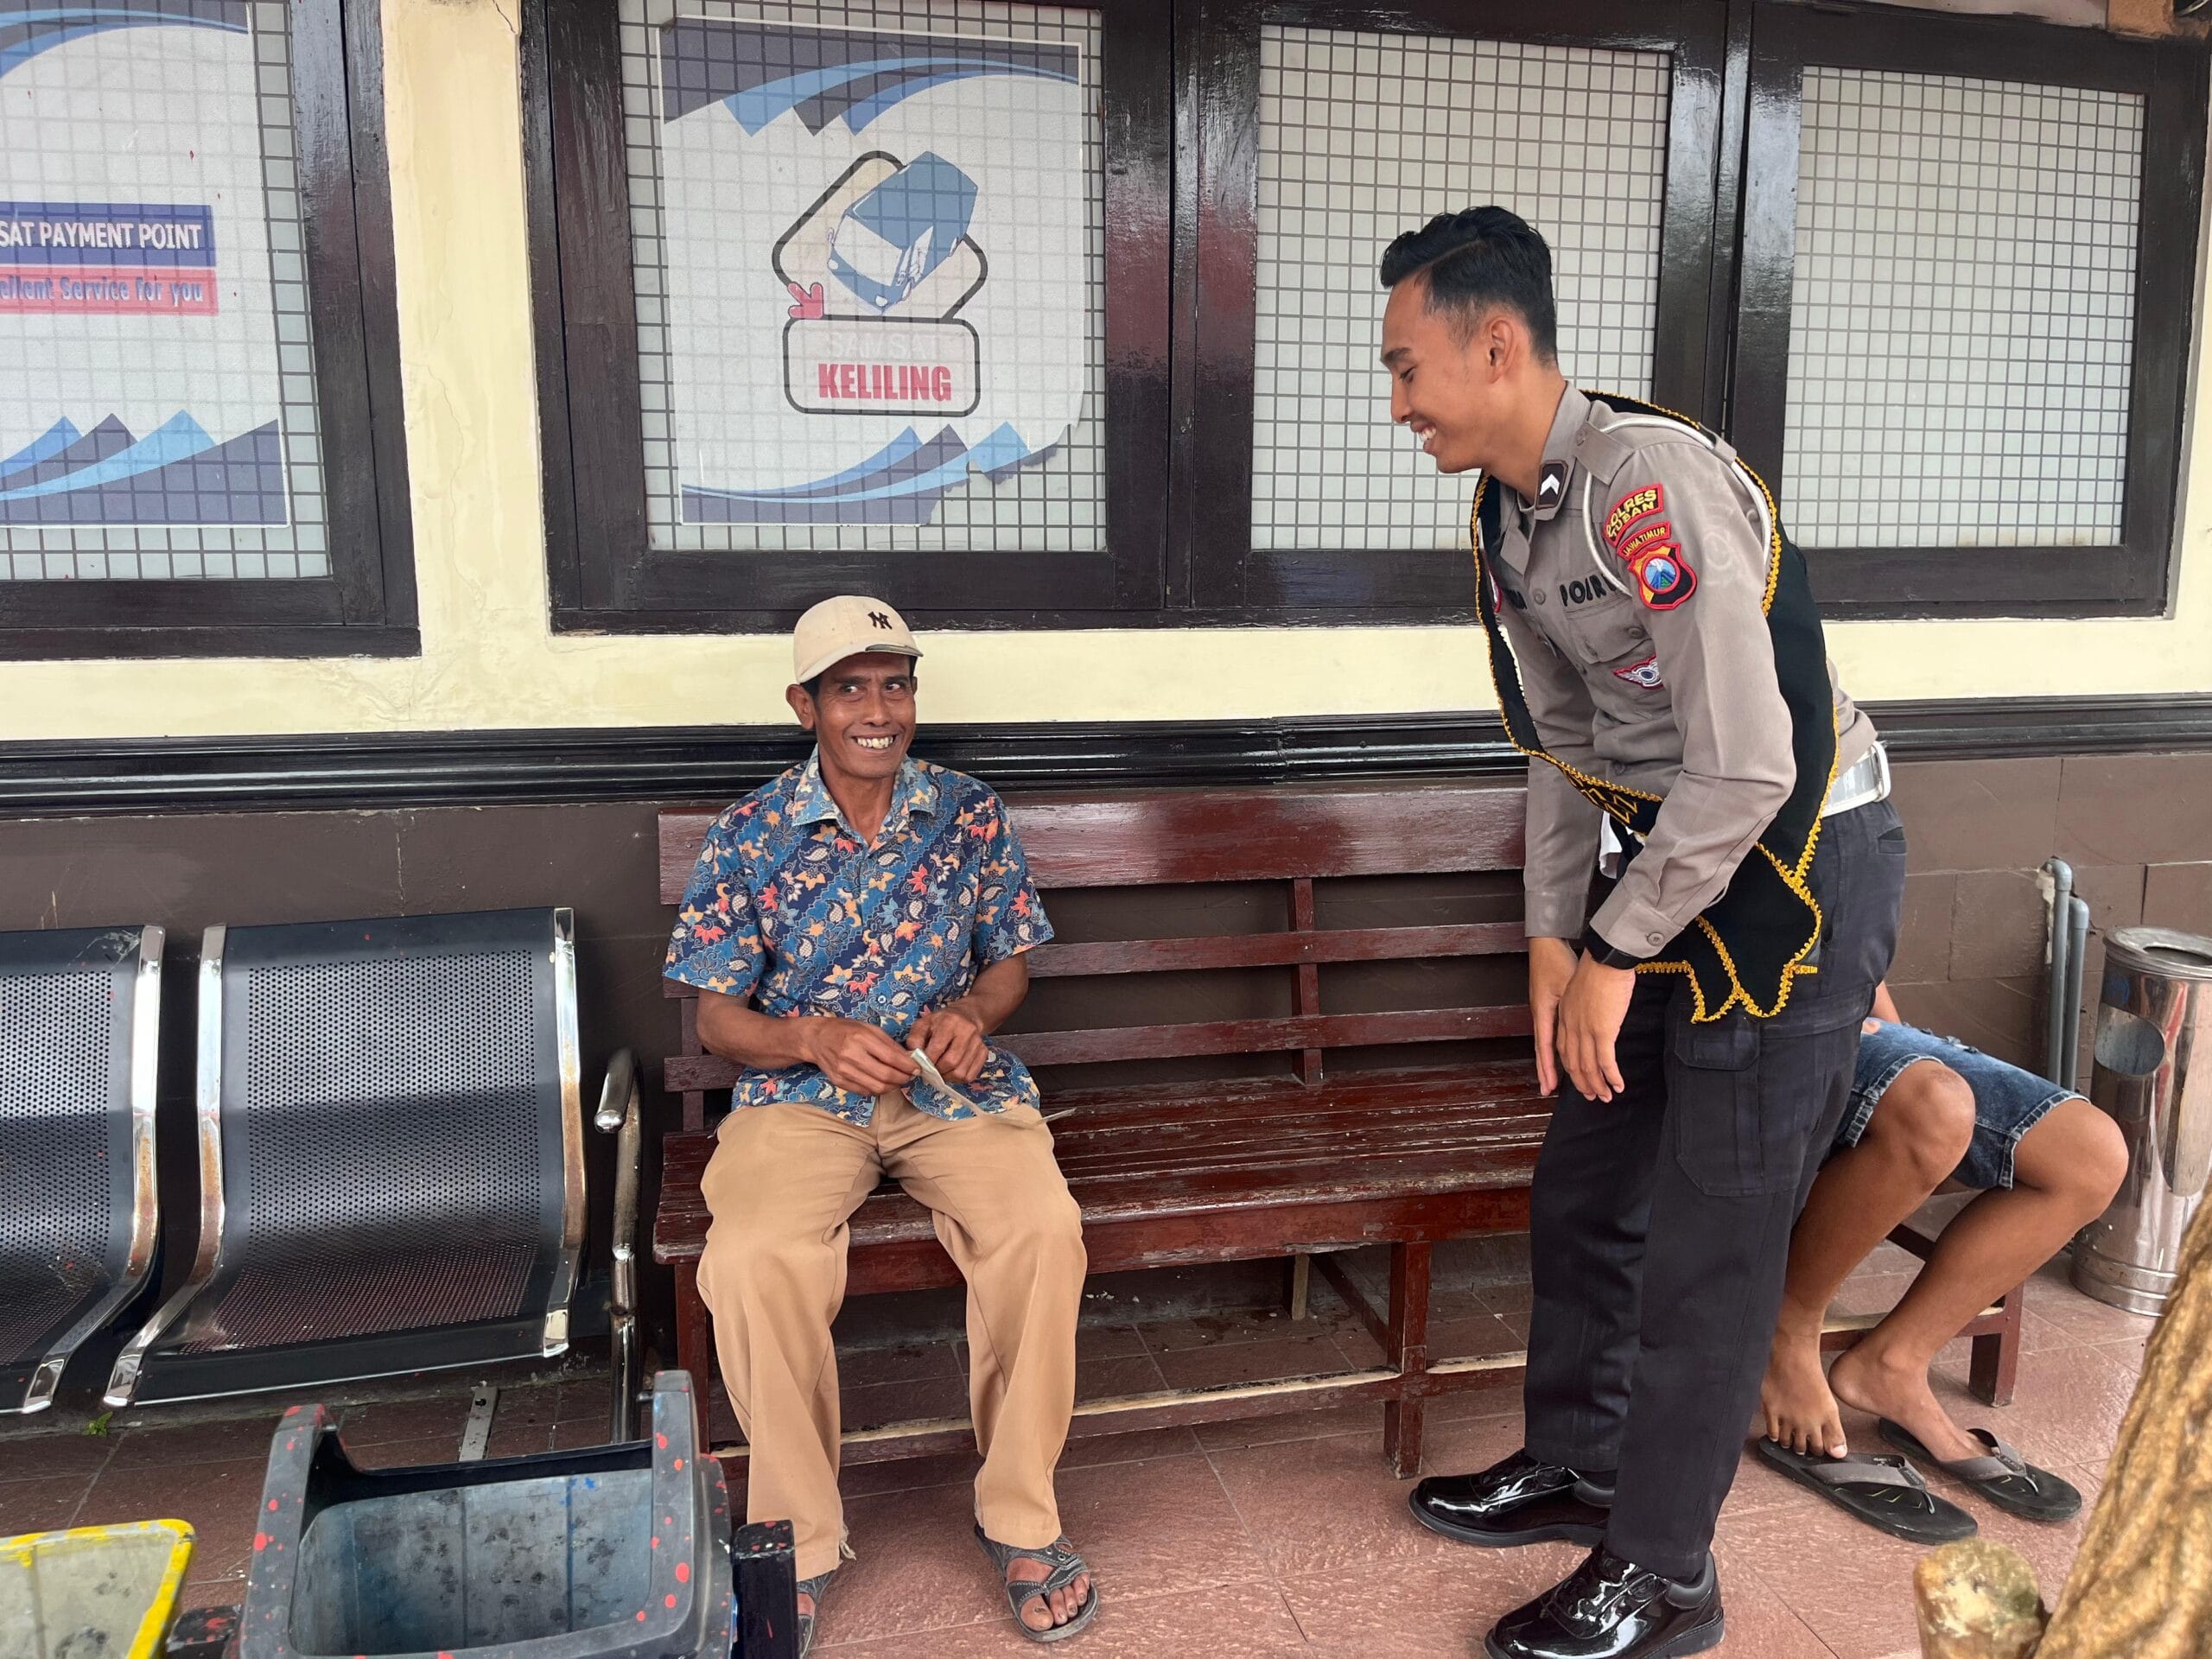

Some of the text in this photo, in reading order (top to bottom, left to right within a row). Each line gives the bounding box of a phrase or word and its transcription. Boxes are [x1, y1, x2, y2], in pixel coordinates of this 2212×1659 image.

[40, 222, 133, 249] PAYMENT
[139, 224, 201, 250] POINT
[60, 276, 130, 301] Service
[136, 276, 164, 302] for
[170, 283, 203, 307] you
[818, 364, 951, 401] KELILING
[1606, 489, 1656, 534] POLRES
[1609, 501, 1654, 537] TUBAN
